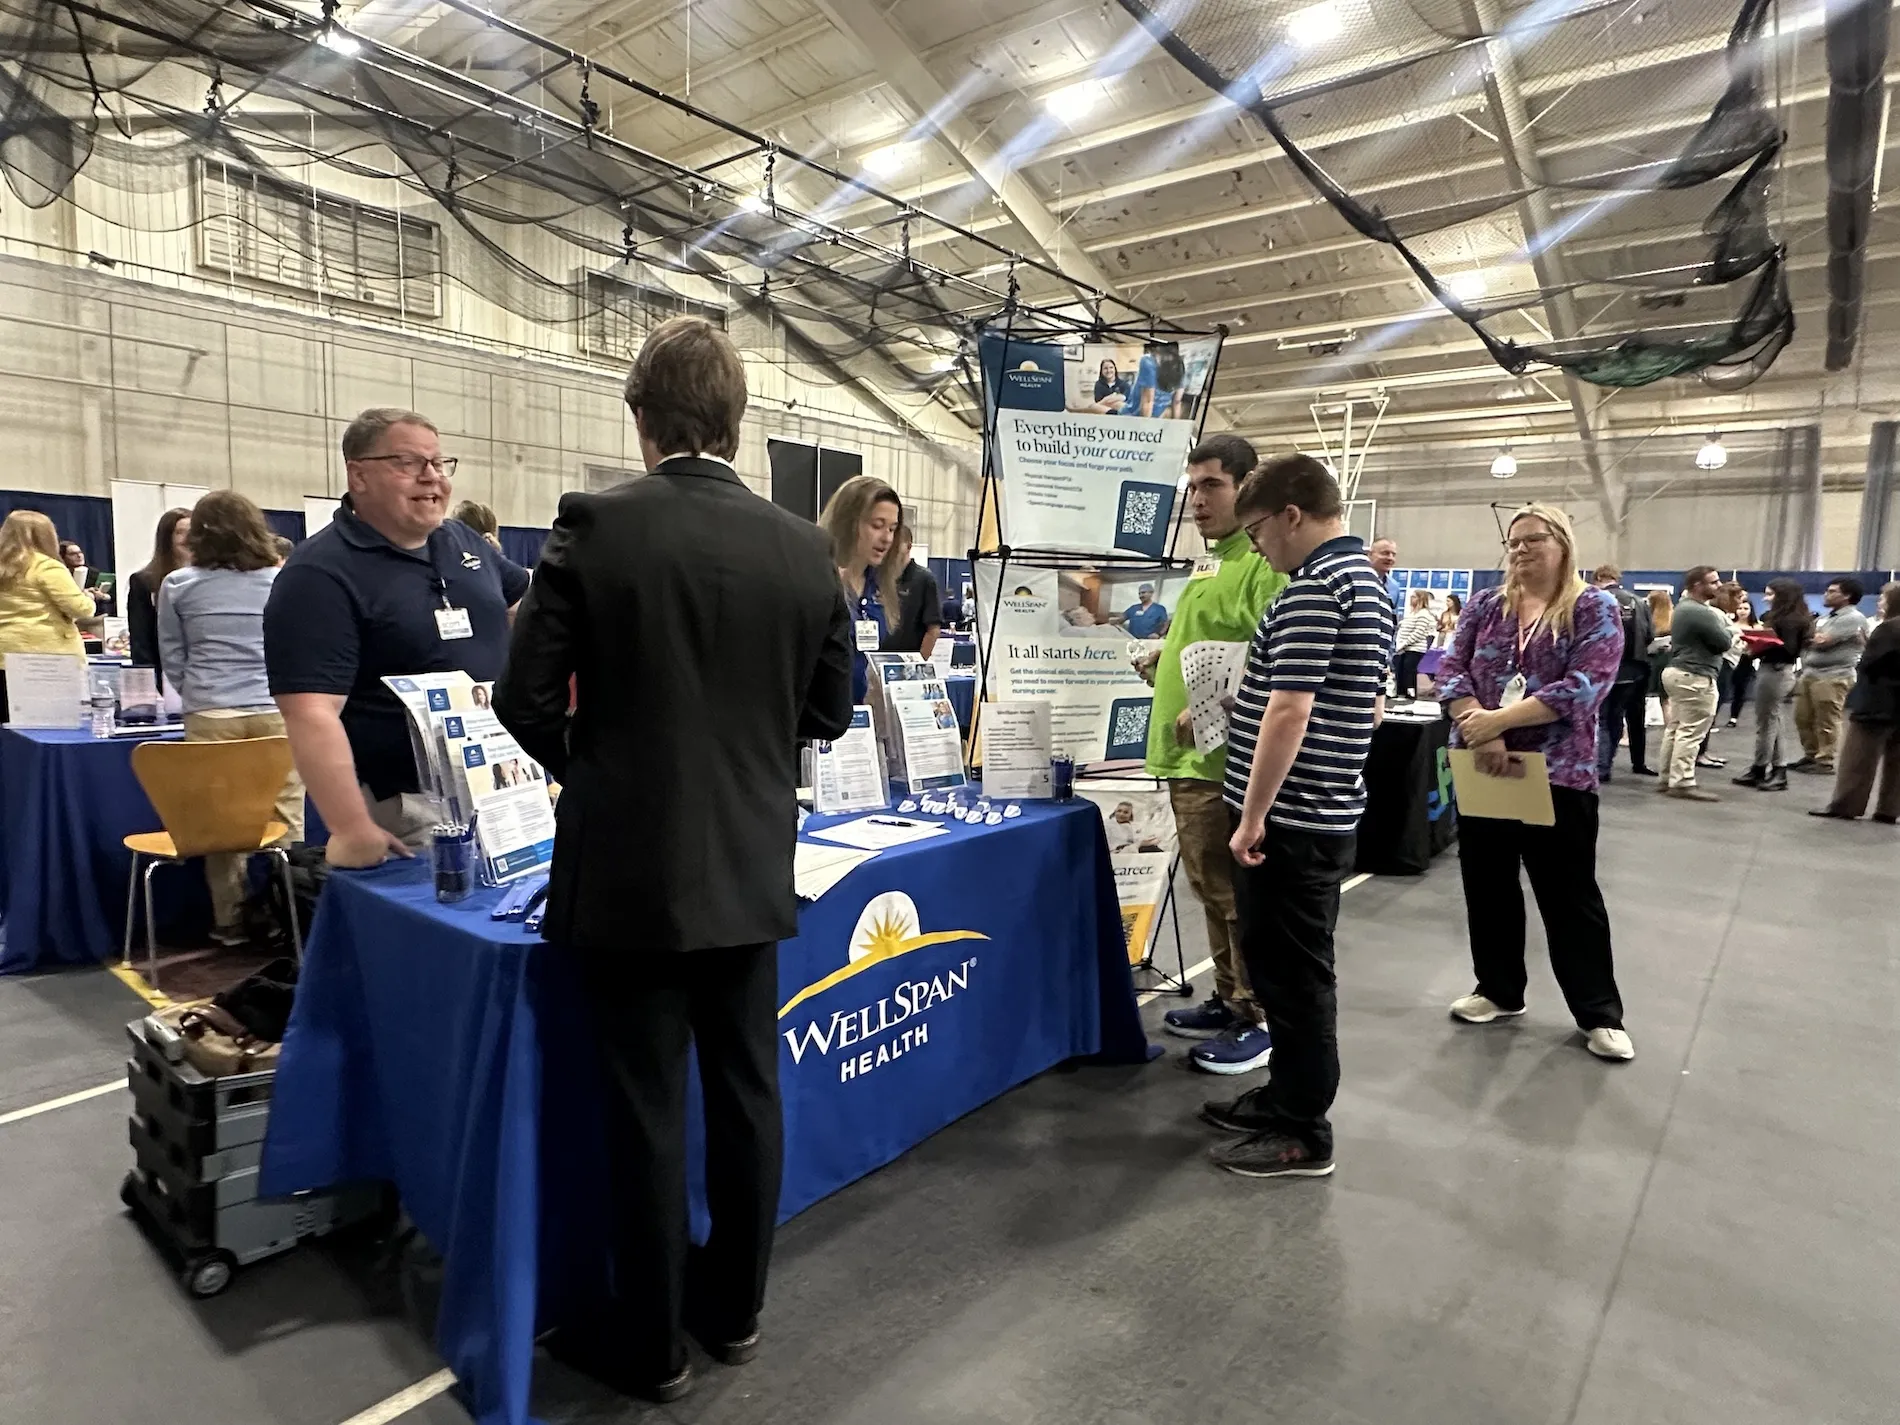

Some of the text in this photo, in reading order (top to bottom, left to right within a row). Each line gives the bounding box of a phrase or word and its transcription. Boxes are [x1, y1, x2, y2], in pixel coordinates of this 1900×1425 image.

[1014, 418, 1163, 443] Everything you need
[1016, 439, 1155, 462] to build your career.
[1008, 644, 1117, 660] It all starts here.
[1012, 687, 1035, 695] nursing
[1043, 775, 1049, 783] 5
[1113, 865, 1154, 876] career.
[840, 1022, 929, 1083] HEALTH
